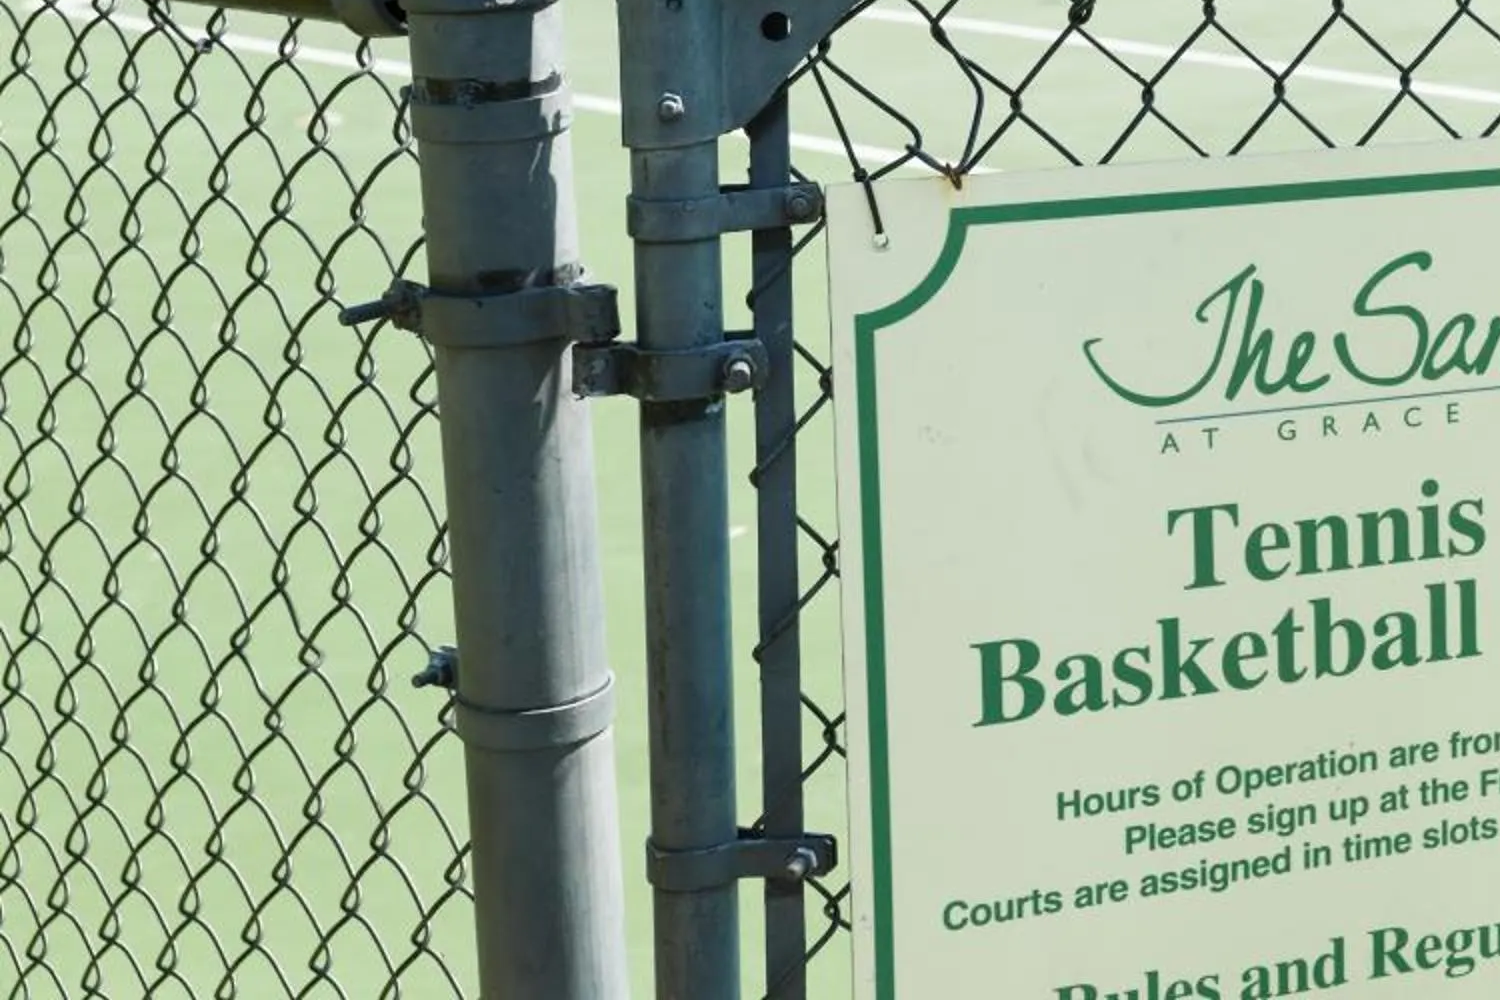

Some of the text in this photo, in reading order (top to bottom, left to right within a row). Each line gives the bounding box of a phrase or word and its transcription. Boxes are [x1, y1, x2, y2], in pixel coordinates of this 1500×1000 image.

[1081, 262, 1331, 408] The
[1160, 426, 1219, 454] AT
[1276, 401, 1459, 441] GRACE
[1166, 477, 1487, 591] Tennis
[968, 577, 1483, 729] Basketball
[1055, 782, 1161, 821] Hours
[1170, 768, 1206, 803] of
[1214, 748, 1378, 799] Operation
[1387, 740, 1440, 769] are
[1123, 815, 1237, 855] Please
[1246, 802, 1317, 838] sign
[1327, 794, 1370, 826] up
[1378, 783, 1410, 814] at
[1417, 776, 1470, 807] the
[941, 887, 1063, 931] Courts
[1072, 878, 1130, 909] are
[1138, 843, 1292, 898] assigned
[1302, 840, 1332, 870] in
[1341, 830, 1413, 863] time
[1421, 814, 1499, 850] slots
[1238, 934, 1349, 1000] and
